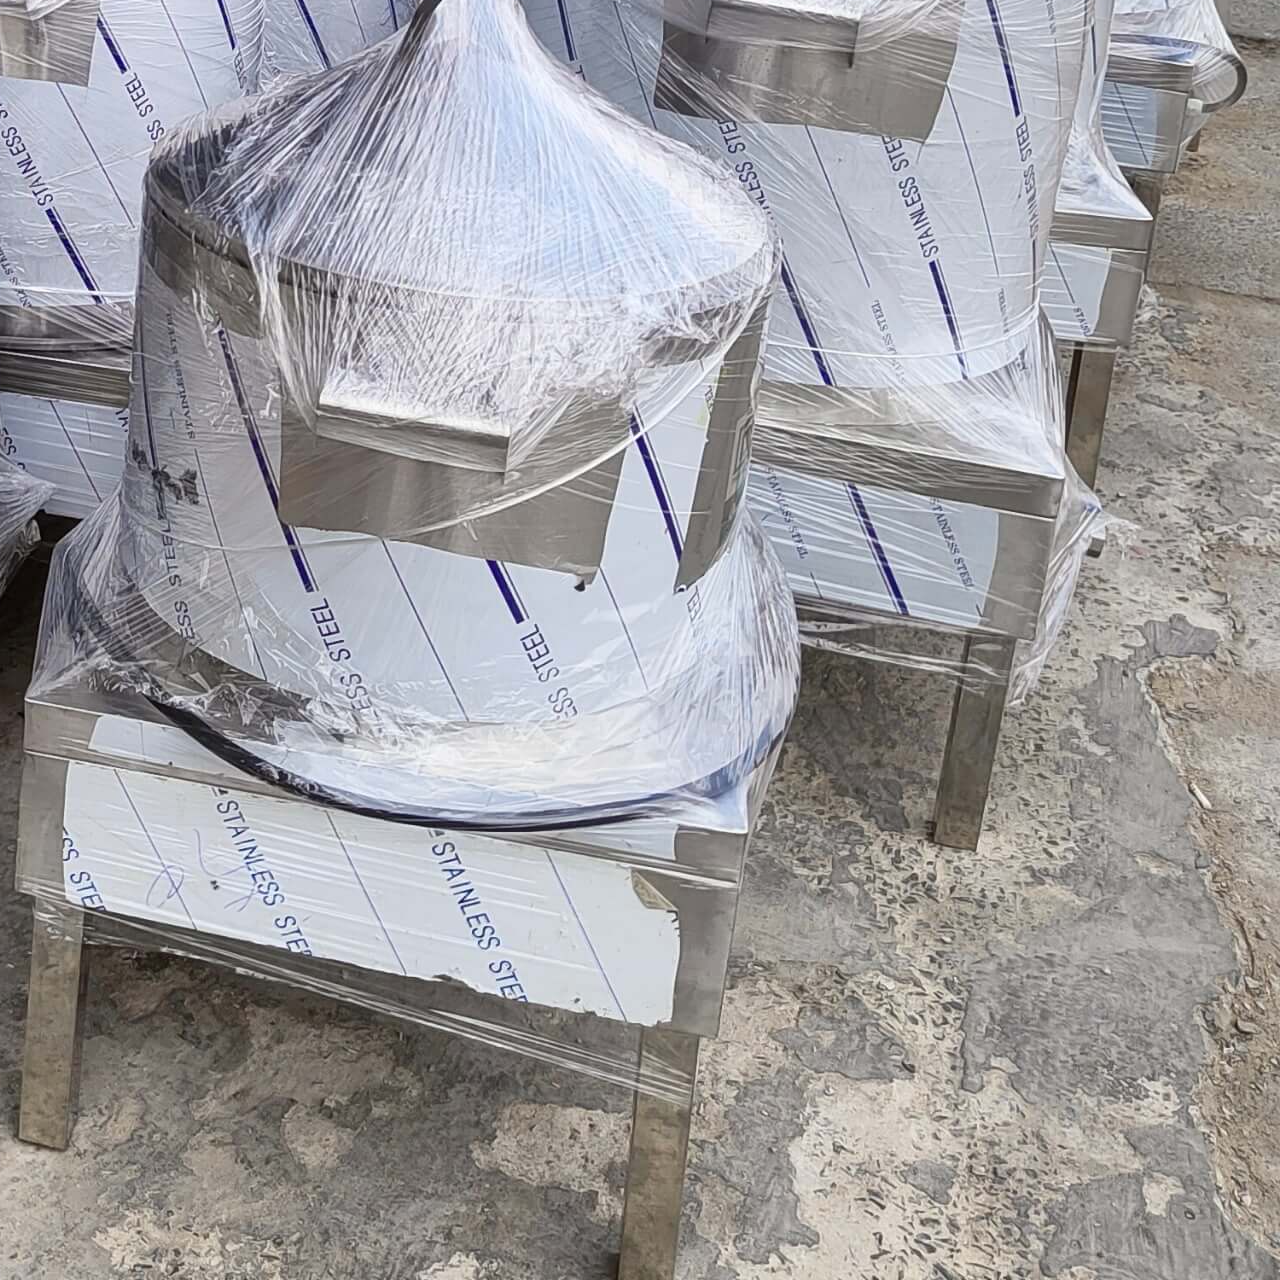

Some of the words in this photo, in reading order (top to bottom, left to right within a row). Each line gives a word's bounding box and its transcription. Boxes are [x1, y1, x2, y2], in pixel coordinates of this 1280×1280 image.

[124, 71, 155, 119] STEEL
[0, 124, 55, 208] STAINLESS
[1016, 115, 1033, 163] STEEL
[897, 175, 940, 260] STAINLESS
[1023, 164, 1040, 240] STAINLESS
[929, 495, 961, 555] STAINLESS
[953, 556, 976, 591] STEEL
[309, 597, 352, 663] STEEL
[519, 623, 560, 683] STEEL
[216, 799, 305, 907] STAINLESS
[431, 841, 501, 951] STAINLESS
